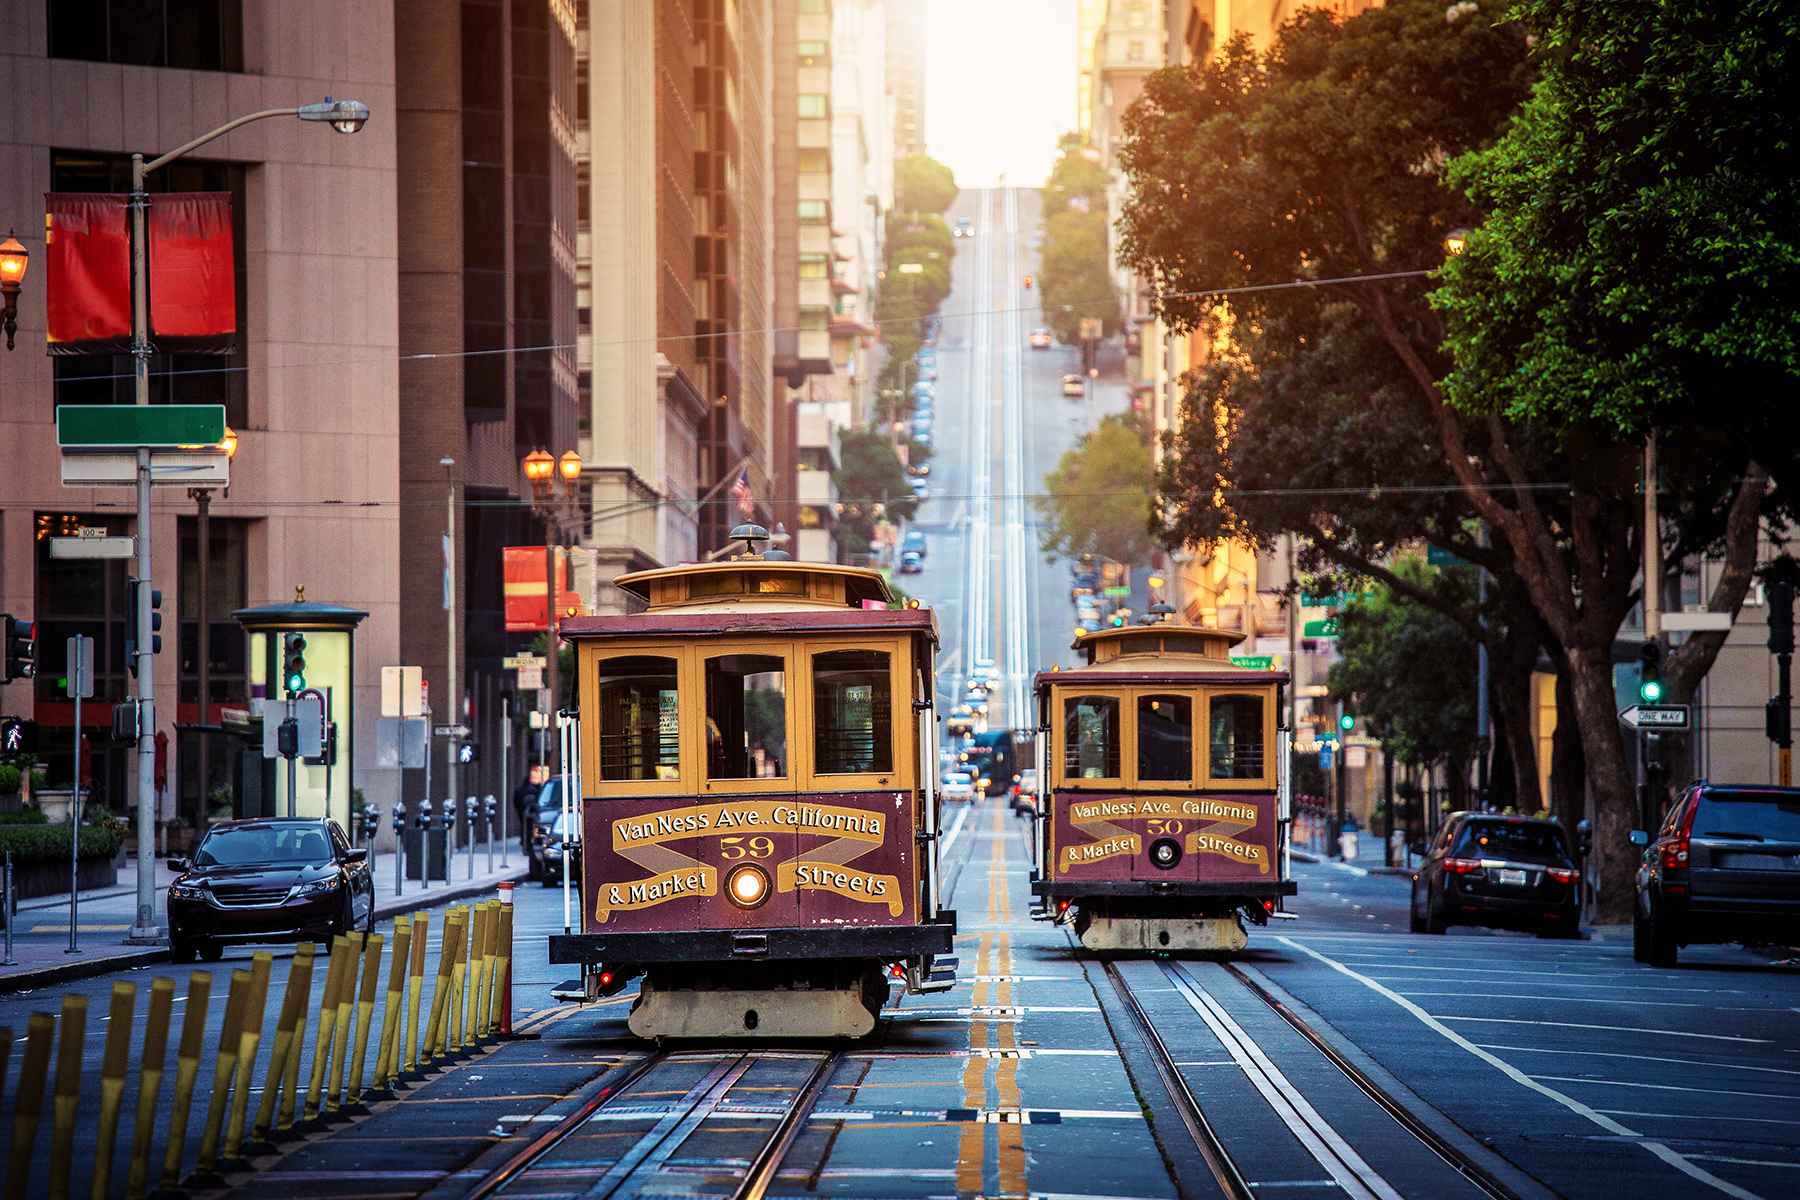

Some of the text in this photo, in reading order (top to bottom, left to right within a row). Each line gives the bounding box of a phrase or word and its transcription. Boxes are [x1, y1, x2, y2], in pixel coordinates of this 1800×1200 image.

[1639, 711, 1680, 720] ONE WAY
[772, 806, 881, 835] California
[1182, 801, 1255, 819] California
[720, 836, 775, 860] 59
[1068, 836, 1259, 860] & Market Streets
[608, 864, 887, 905] & Market Streets
